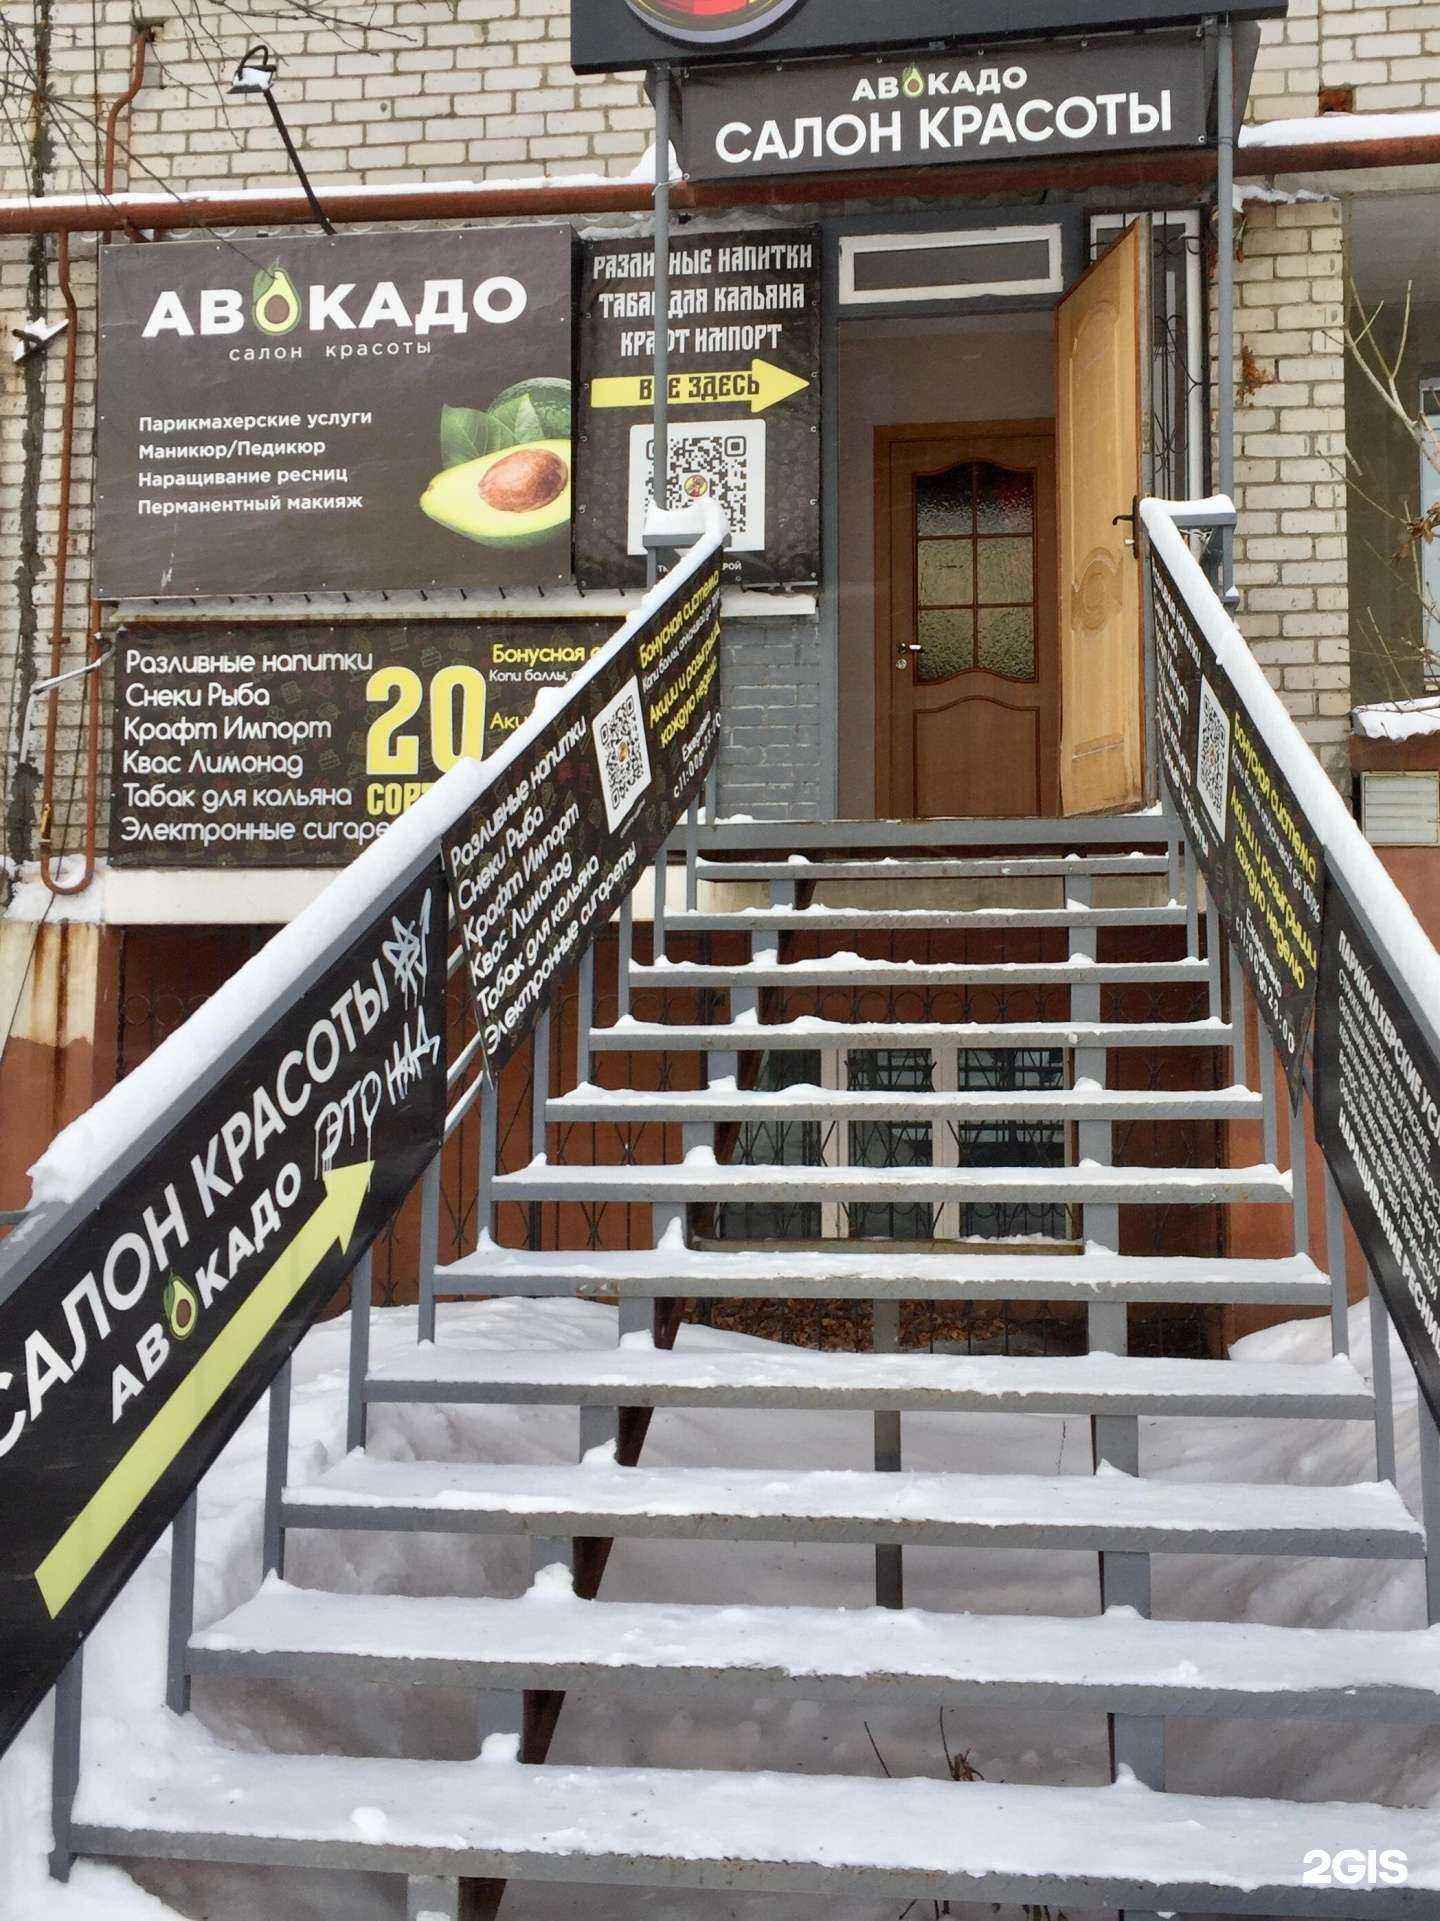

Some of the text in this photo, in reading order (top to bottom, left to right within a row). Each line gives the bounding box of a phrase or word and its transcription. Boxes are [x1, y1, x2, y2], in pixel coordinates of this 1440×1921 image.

[716, 90, 1171, 164] САЛОН КРАСОТЫ
[593, 244, 813, 280] РАЗЛИНЫЕ НАПИТКИ
[667, 288, 708, 319] ДЛЯ
[714, 283, 806, 312] КАЛЬЯНА
[229, 341, 431, 361] салон красоты
[695, 324, 782, 353] ИМПОРТ
[639, 373, 760, 401] ВЕ ЗДЕСЬ
[139, 411, 372, 434] Парикмахерские услуги
[139, 440, 326, 461] Маникюр/Педикюр
[138, 467, 348, 490] Наращивание ресниц
[138, 495, 363, 517] Перманентный макияж
[640, 569, 720, 669] Бонусная система
[126, 649, 373, 674] Разливные напитки
[492, 644, 585, 667] Бонусная
[489, 669, 522, 682] Копи
[524, 669, 568, 682] баллы,
[125, 682, 270, 707] Снеки Рыба
[650, 682, 679, 729] Акции
[123, 716, 332, 746] Крафт Импорт
[366, 665, 487, 775] 20
[661, 695, 695, 749] каждую
[122, 750, 303, 779] Квас Лимонад
[122, 782, 352, 813] Табак для кальяна
[450, 716, 587, 877] Разливные напитки
[1235, 711, 1316, 882] Бонусная система
[120, 816, 295, 846] Электронные
[458, 806, 544, 910] Снеки Рыба
[463, 802, 580, 950] Крафт Импорт
[470, 851, 573, 987] Квас Лимонад
[1235, 834, 1305, 989] каждую неделю
[476, 855, 600, 1017] Табак для кальяна
[484, 841, 637, 1056] Электронные сигареты
[190, 959, 390, 1218] КРАСОТЫ
